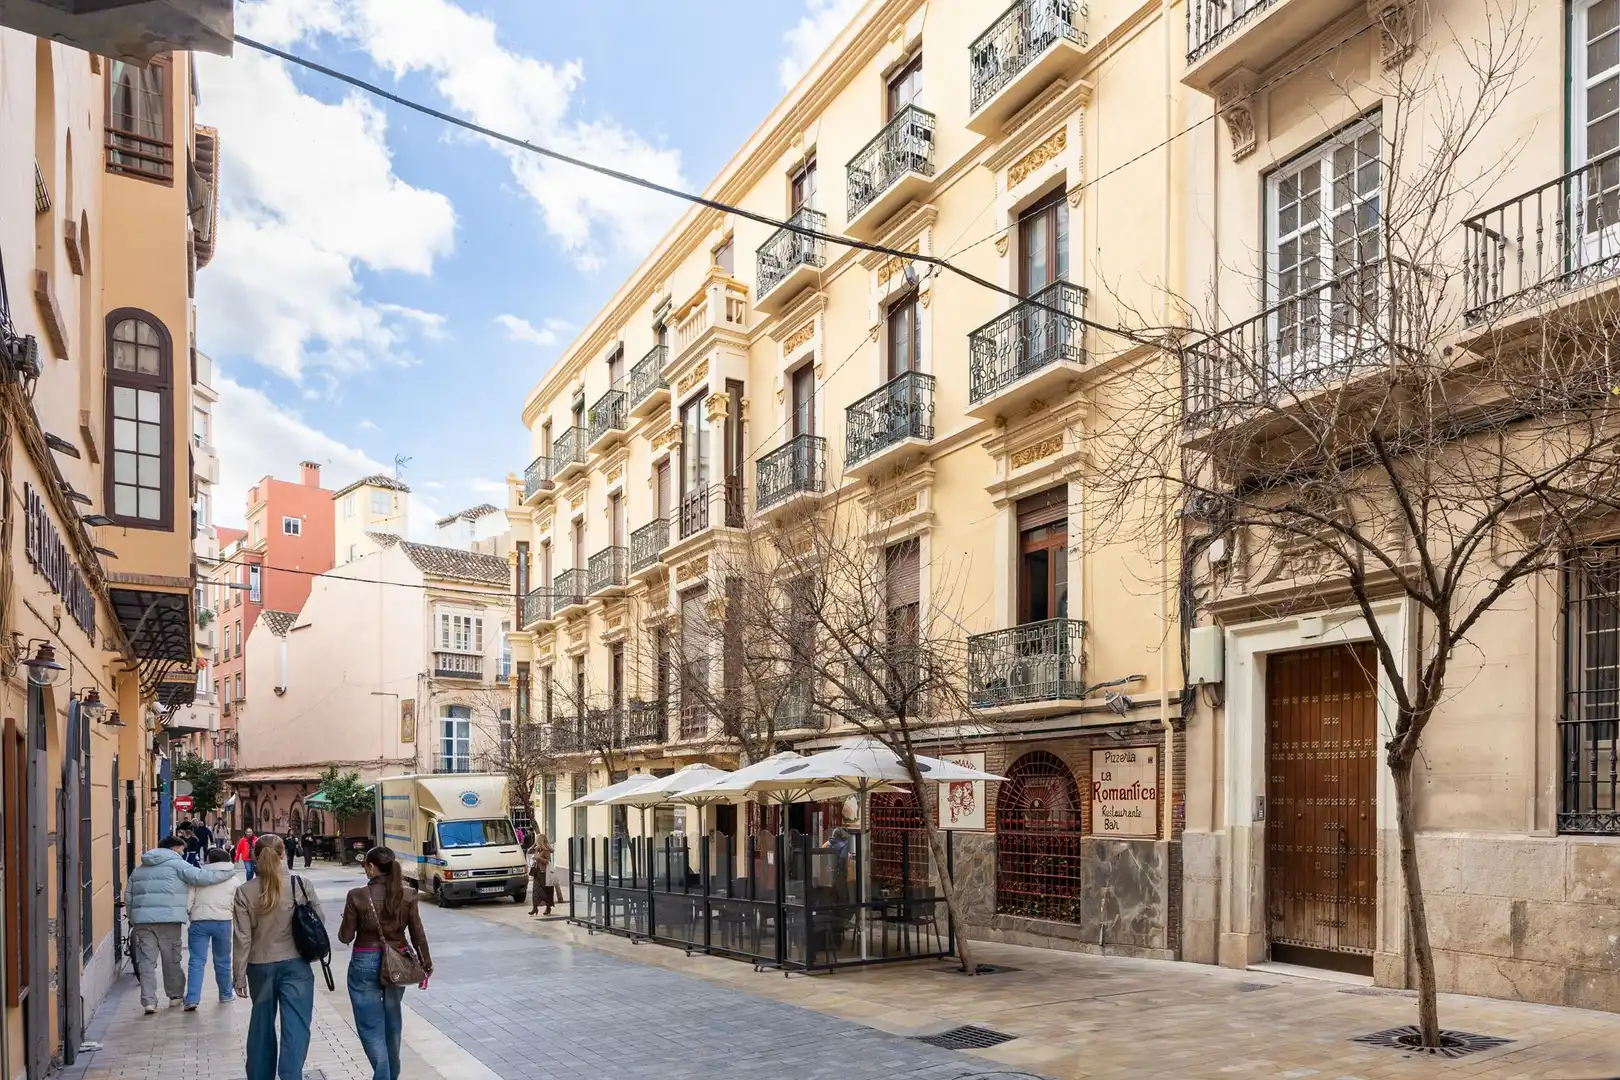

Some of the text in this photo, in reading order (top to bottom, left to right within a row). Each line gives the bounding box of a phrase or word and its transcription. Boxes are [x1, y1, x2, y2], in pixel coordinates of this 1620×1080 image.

[1105, 751, 1136, 764] Pizzeria
[1101, 771, 1112, 782] La
[1101, 805, 1142, 818] Restaurante
[1104, 818, 1119, 830] Bar
